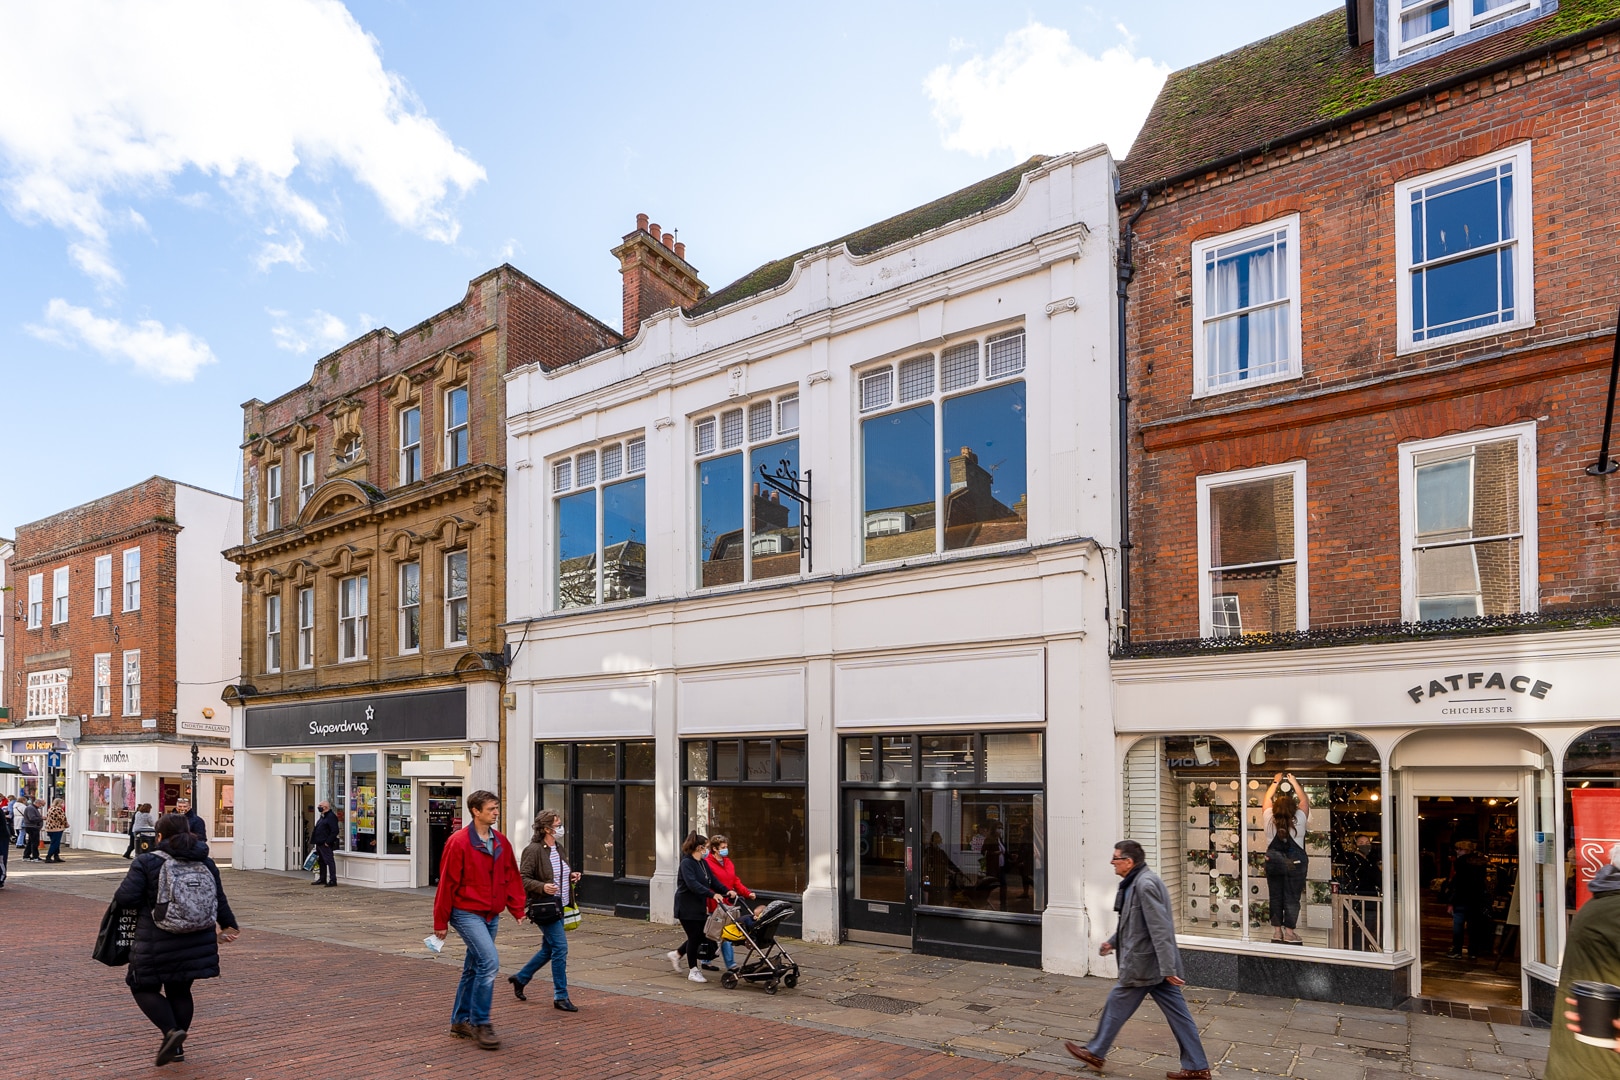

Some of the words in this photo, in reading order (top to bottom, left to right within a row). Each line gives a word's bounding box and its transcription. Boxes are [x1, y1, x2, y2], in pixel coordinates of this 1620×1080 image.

[1408, 672, 1553, 704] FATFACE
[1441, 706, 1513, 715] CHICHESTER
[309, 720, 369, 737] Superdrug
[25, 741, 35, 750] Card
[36, 740, 53, 750] Factory
[103, 751, 129, 762] PANDORA
